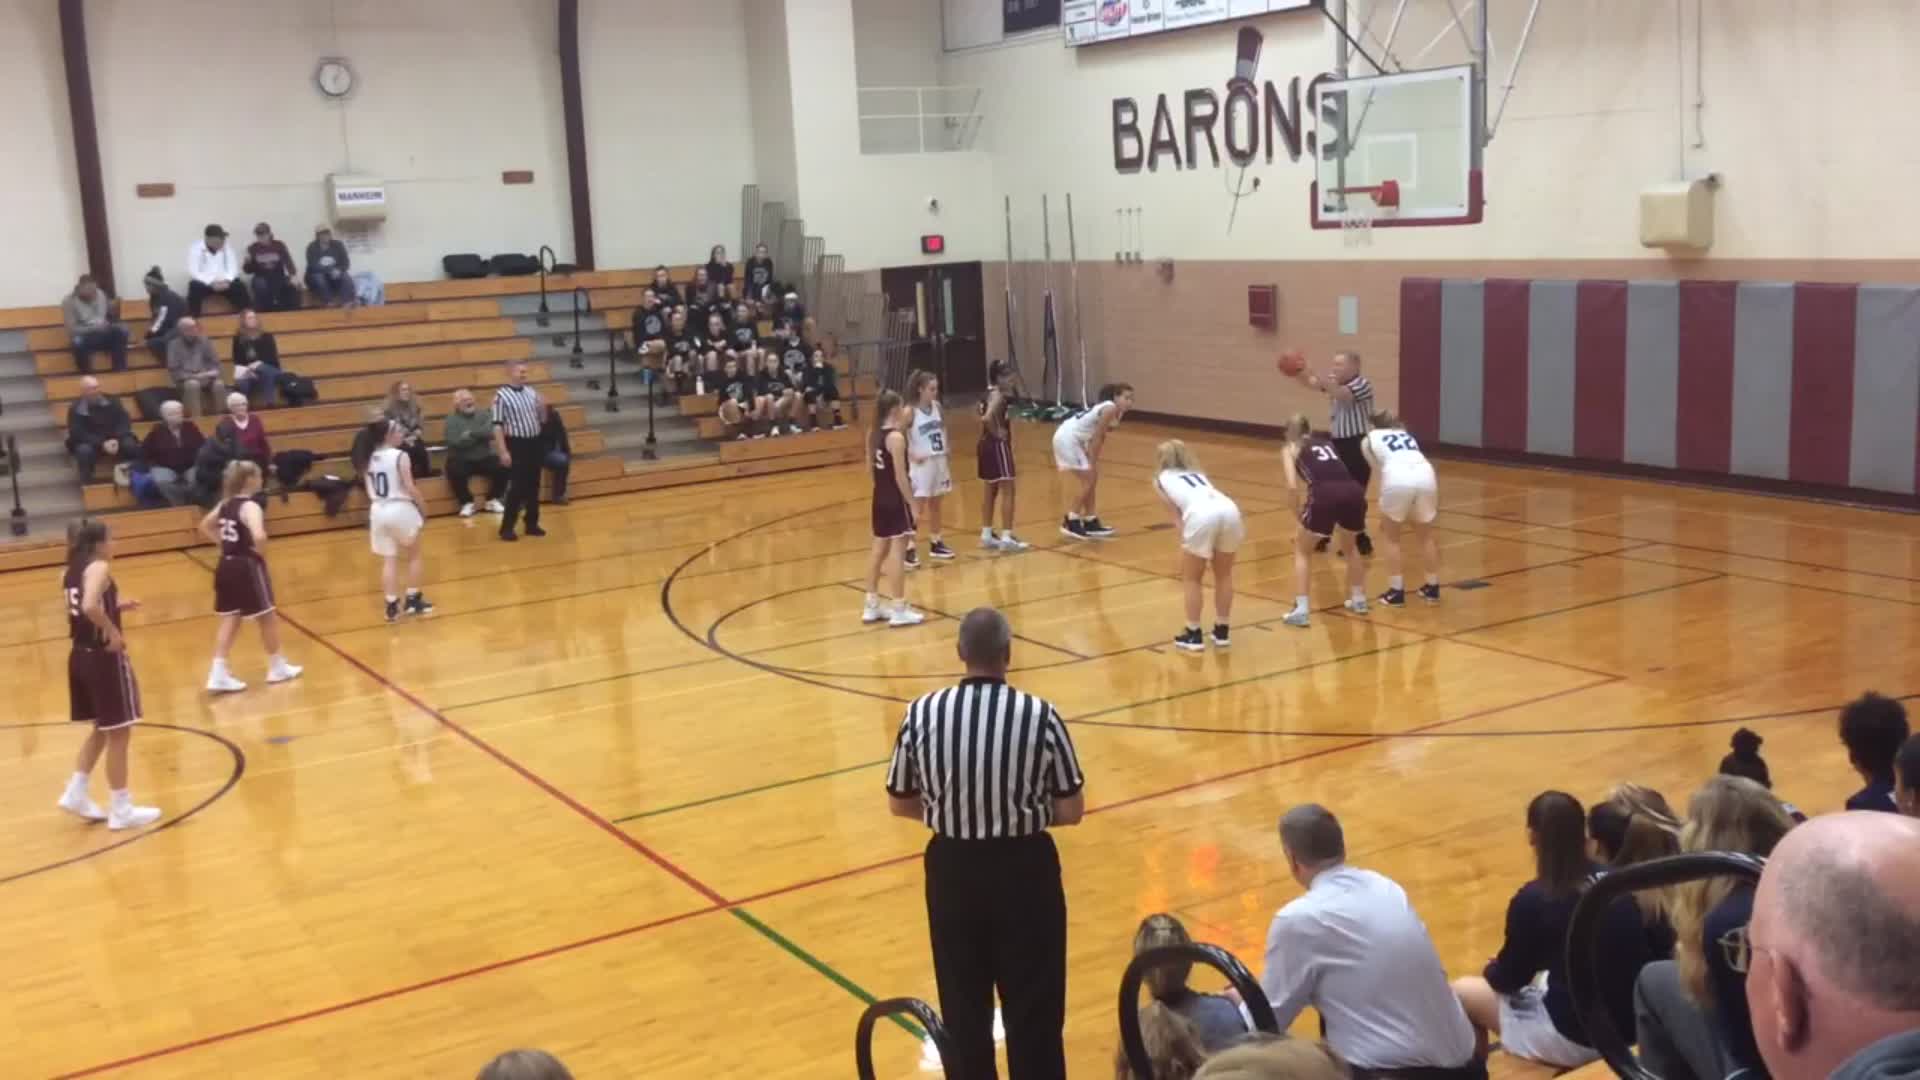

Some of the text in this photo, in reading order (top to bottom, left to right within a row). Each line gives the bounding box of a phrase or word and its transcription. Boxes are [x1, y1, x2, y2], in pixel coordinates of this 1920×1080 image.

[1112, 72, 1350, 175] BARONS
[928, 432, 943, 452] 15
[1382, 433, 1417, 452] 22
[1312, 445, 1338, 461] 31
[1179, 474, 1207, 488] 11
